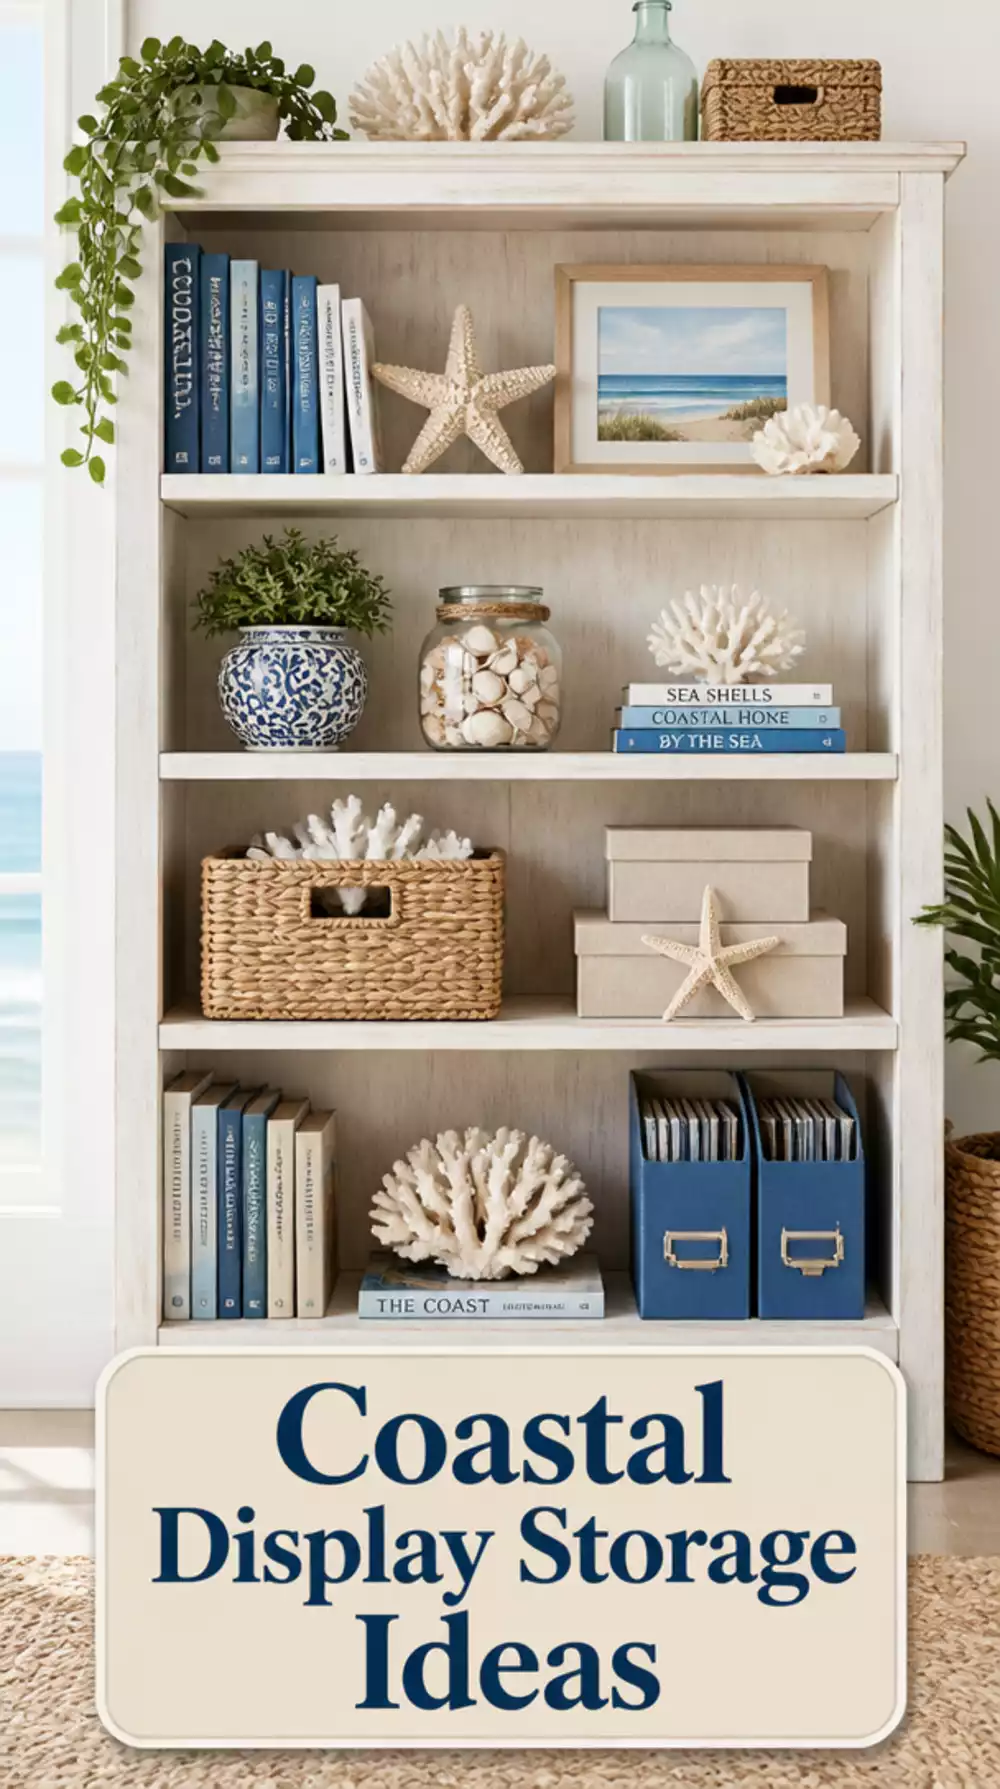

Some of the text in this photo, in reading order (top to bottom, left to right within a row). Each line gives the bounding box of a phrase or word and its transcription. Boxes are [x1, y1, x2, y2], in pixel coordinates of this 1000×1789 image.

[667, 688, 772, 702] SEA SHELLS
[652, 710, 732, 725] COASTAL
[659, 734, 763, 748] BY THE SEA
[376, 1298, 415, 1313] THE
[423, 1298, 490, 1313] COAST
